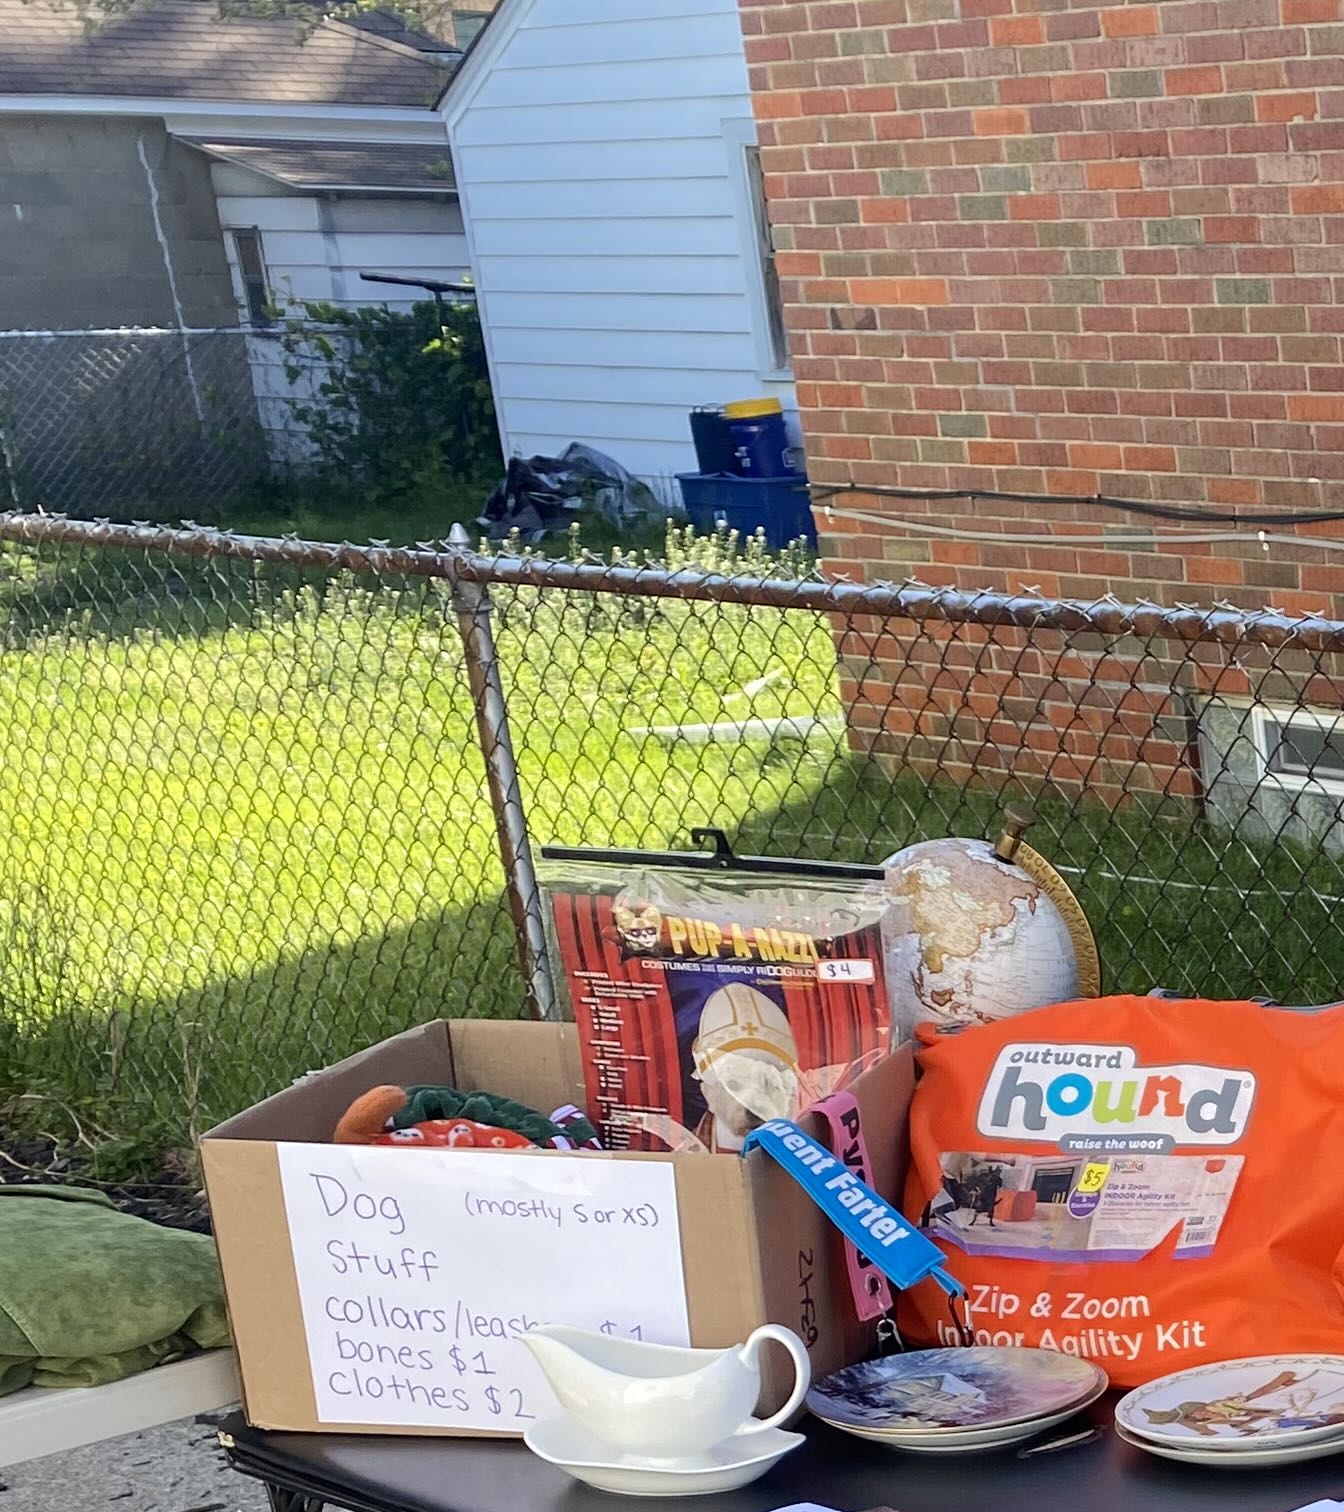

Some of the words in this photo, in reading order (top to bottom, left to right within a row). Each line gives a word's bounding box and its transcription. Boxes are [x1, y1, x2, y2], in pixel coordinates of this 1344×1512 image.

[641, 960, 701, 972] COSTUMES
[717, 964, 755, 976] SIMPLY
[828, 963, 851, 978] $4
[1009, 1047, 1122, 1070] outward
[990, 1065, 1243, 1135] hound
[1067, 1137, 1102, 1151] raise
[1104, 1137, 1126, 1150] the
[1128, 1137, 1164, 1151] woof
[1083, 1169, 1102, 1186] $5
[309, 1173, 406, 1235] Dog
[465, 1191, 562, 1227] (mostly
[577, 1203, 588, 1224] S
[595, 1208, 615, 1225] or
[825, 1172, 910, 1247] Farter
[1137, 1193, 1162, 1201] Agility
[325, 1239, 440, 1282] Stuff
[970, 1285, 1019, 1318] Zip
[1030, 1292, 1051, 1318] &
[1061, 1290, 1151, 1320] Zoom
[937, 1319, 1024, 1347] Inoor
[1155, 1321, 1206, 1350] Kit
[336, 1332, 433, 1371] bones
[449, 1344, 496, 1377] $1
[329, 1369, 470, 1412] clothes
[485, 1385, 536, 1420] $2
